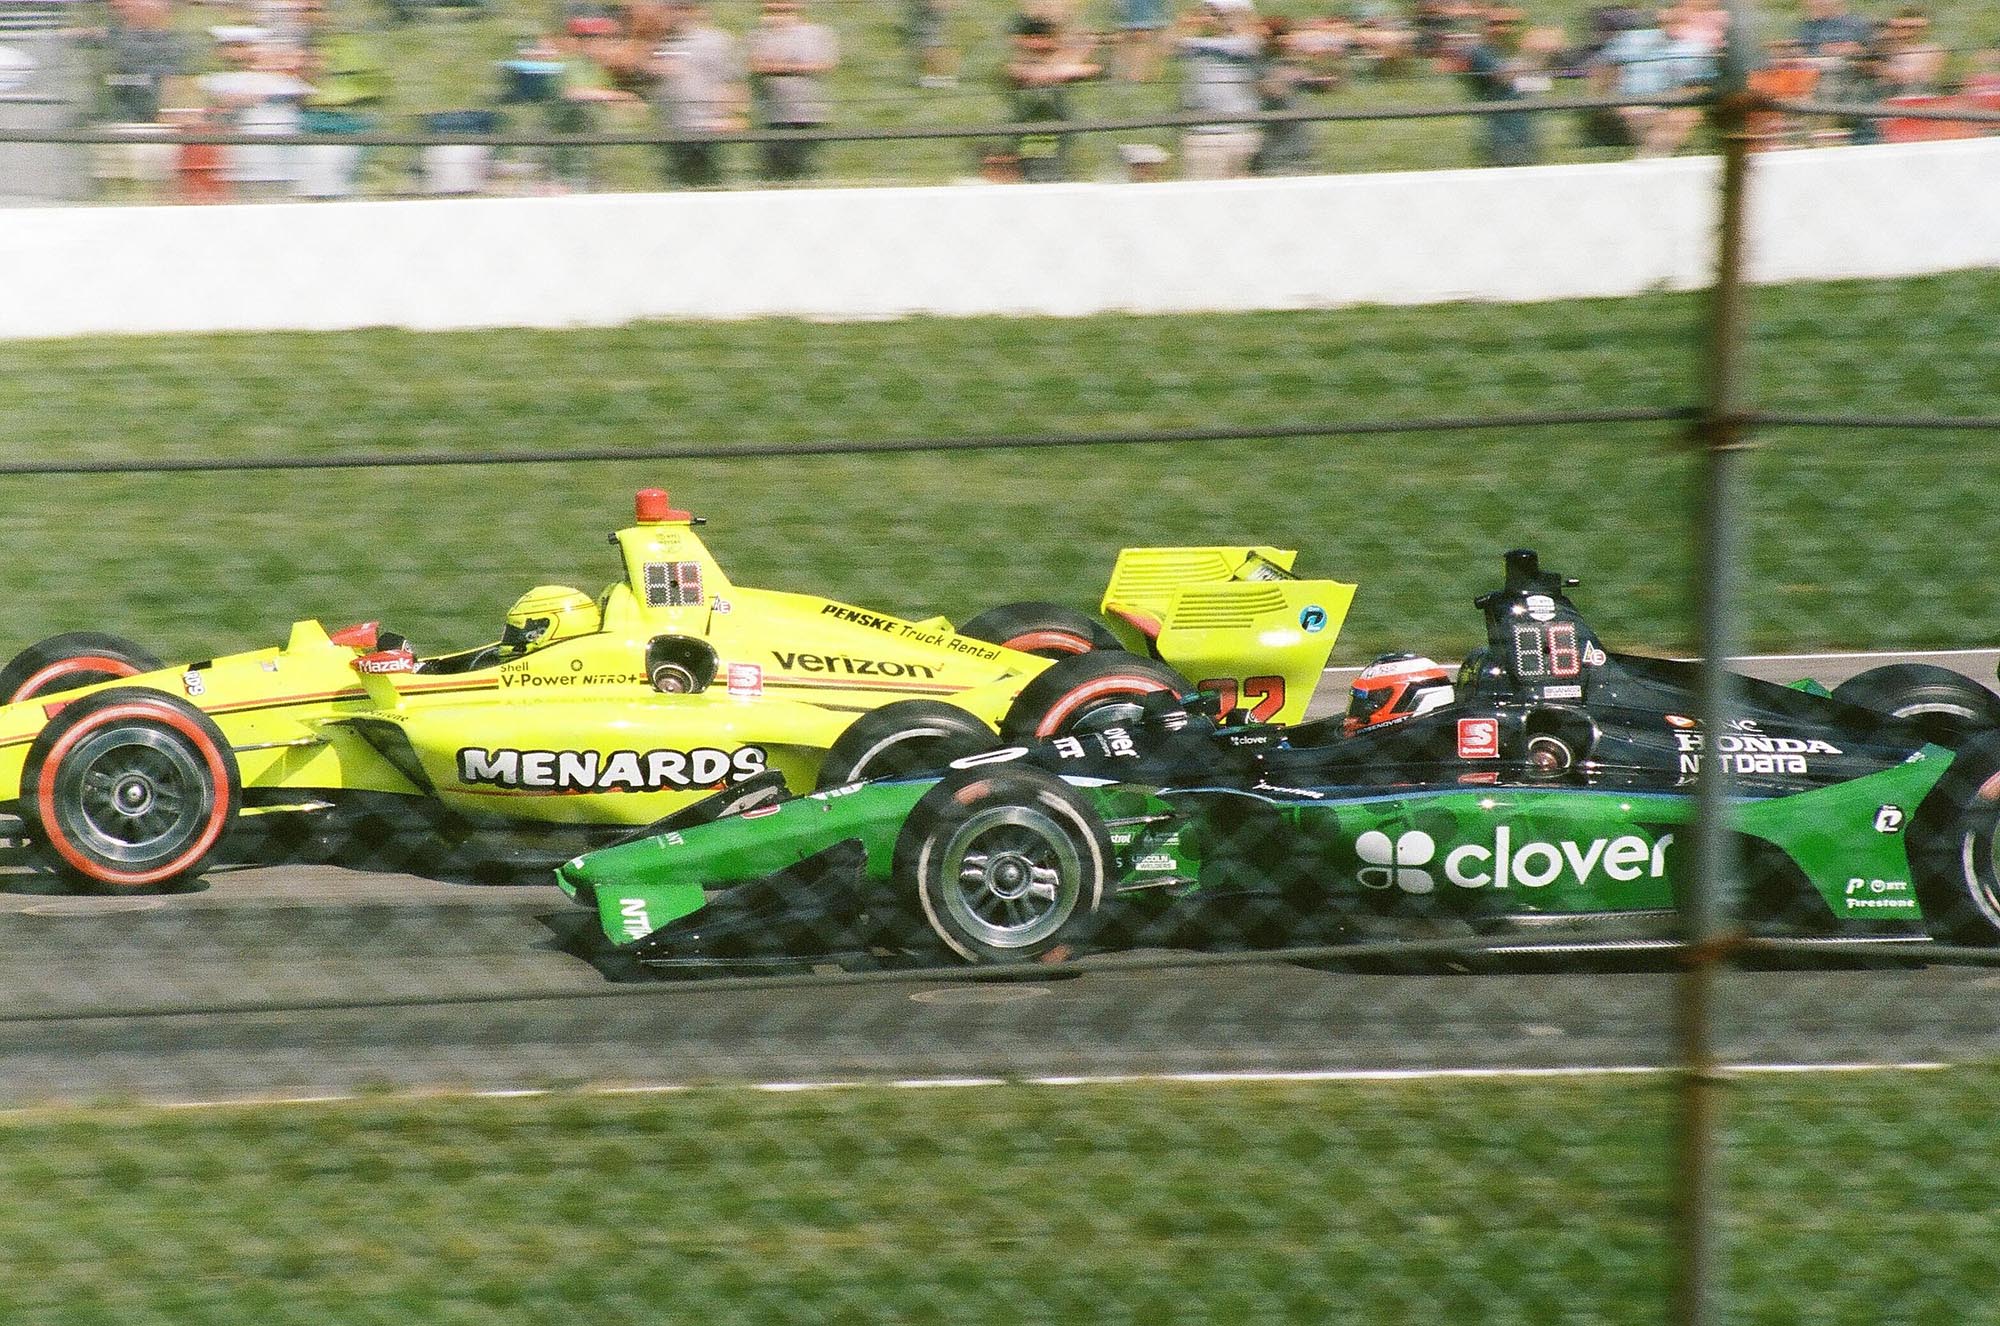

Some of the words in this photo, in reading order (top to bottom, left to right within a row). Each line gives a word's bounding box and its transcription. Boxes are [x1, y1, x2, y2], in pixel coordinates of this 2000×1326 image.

[820, 604, 897, 634] PENSKE
[899, 625, 945, 647] Truck
[949, 638, 1001, 661] Rental
[358, 657, 412, 673] Mazak
[500, 661, 529, 672] Shell
[771, 650, 934, 679] verizon
[501, 673, 577, 687] V-Power
[1239, 736, 1267, 745] clover
[459, 748, 767, 788] MENARDS
[1444, 826, 1674, 888] clover
[1846, 898, 1915, 908] Firestone
